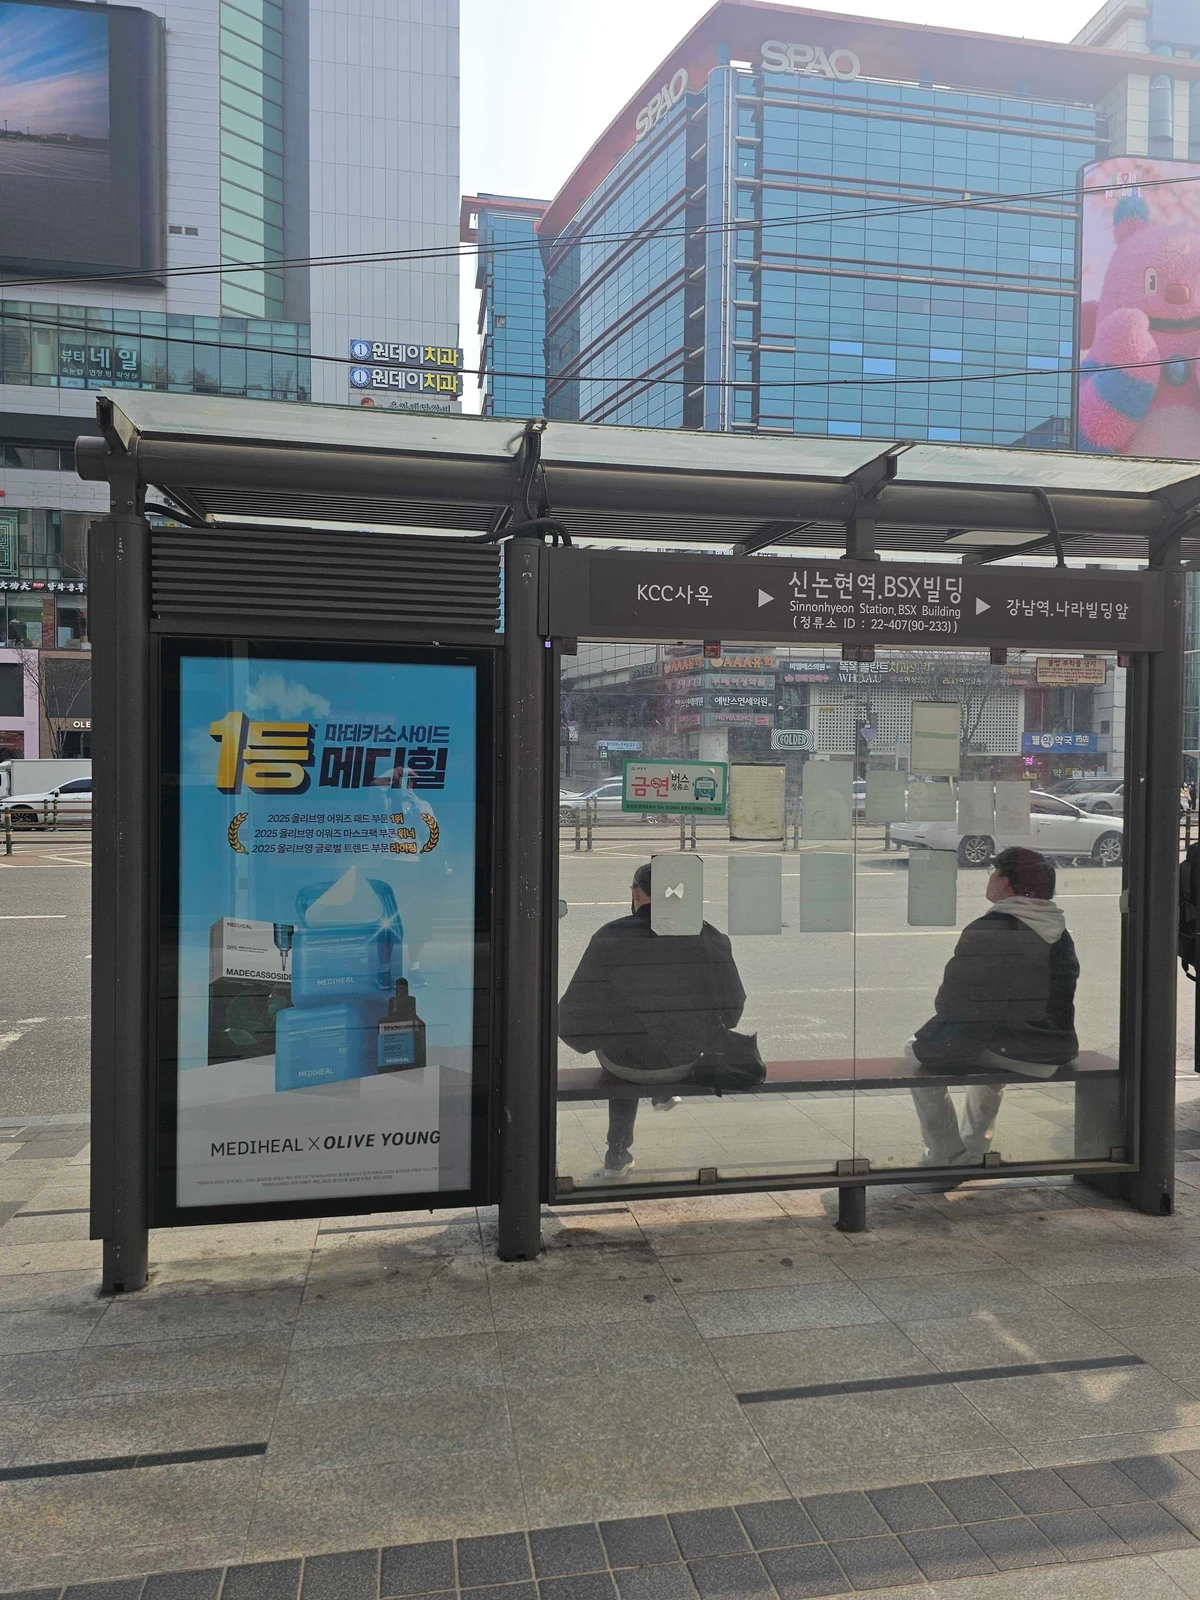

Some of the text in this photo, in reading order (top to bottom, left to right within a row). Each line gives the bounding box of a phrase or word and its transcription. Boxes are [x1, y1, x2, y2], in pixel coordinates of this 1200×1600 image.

[761, 40, 860, 83] SPAO
[636, 68, 688, 142] SPAO
[61, 347, 138, 371] 뷰티 네일
[372, 342, 459, 366] 원데이치과
[371, 369, 459, 393] 원데이치과
[637, 584, 713, 606] KCC사옥
[788, 570, 963, 604] 신논현역.BSX빌딩
[790, 600, 855, 615] Sinnonhyeon
[922, 605, 961, 619] Building
[1006, 598, 1129, 620] 강남역.나라빌딩앞
[843, 618, 856, 629] ID
[723, 655, 775, 669] AAA유학
[714, 696, 768, 707] 에반스연세의원
[325, 723, 450, 744] 마데카소사이드
[779, 732, 807, 746] FOLDER
[1055, 735, 1072, 746] 약국
[209, 712, 316, 796] 1등
[318, 746, 449, 790] 메디힐
[631, 776, 670, 798] 금연
[671, 773, 690, 784] 버스
[671, 783, 690, 792] 정류소
[267, 813, 405, 824] 2025 올리브영 어워즈 패드 부문 1위
[254, 827, 416, 839] 2025 올리브영 어워즈 마스크팩 부문 위너
[251, 842, 417, 854] 2025 올리브영 글로벌 트렌드 부문 라이징
[226, 968, 292, 981] MADECASSOSIDE
[316, 976, 355, 986] MEDIHEAL
[298, 1067, 334, 1078] MEDIHEAL
[211, 1138, 304, 1157] MEDIHEAL
[323, 1133, 375, 1150] OLIVE
[382, 1130, 441, 1147] YOUNG
